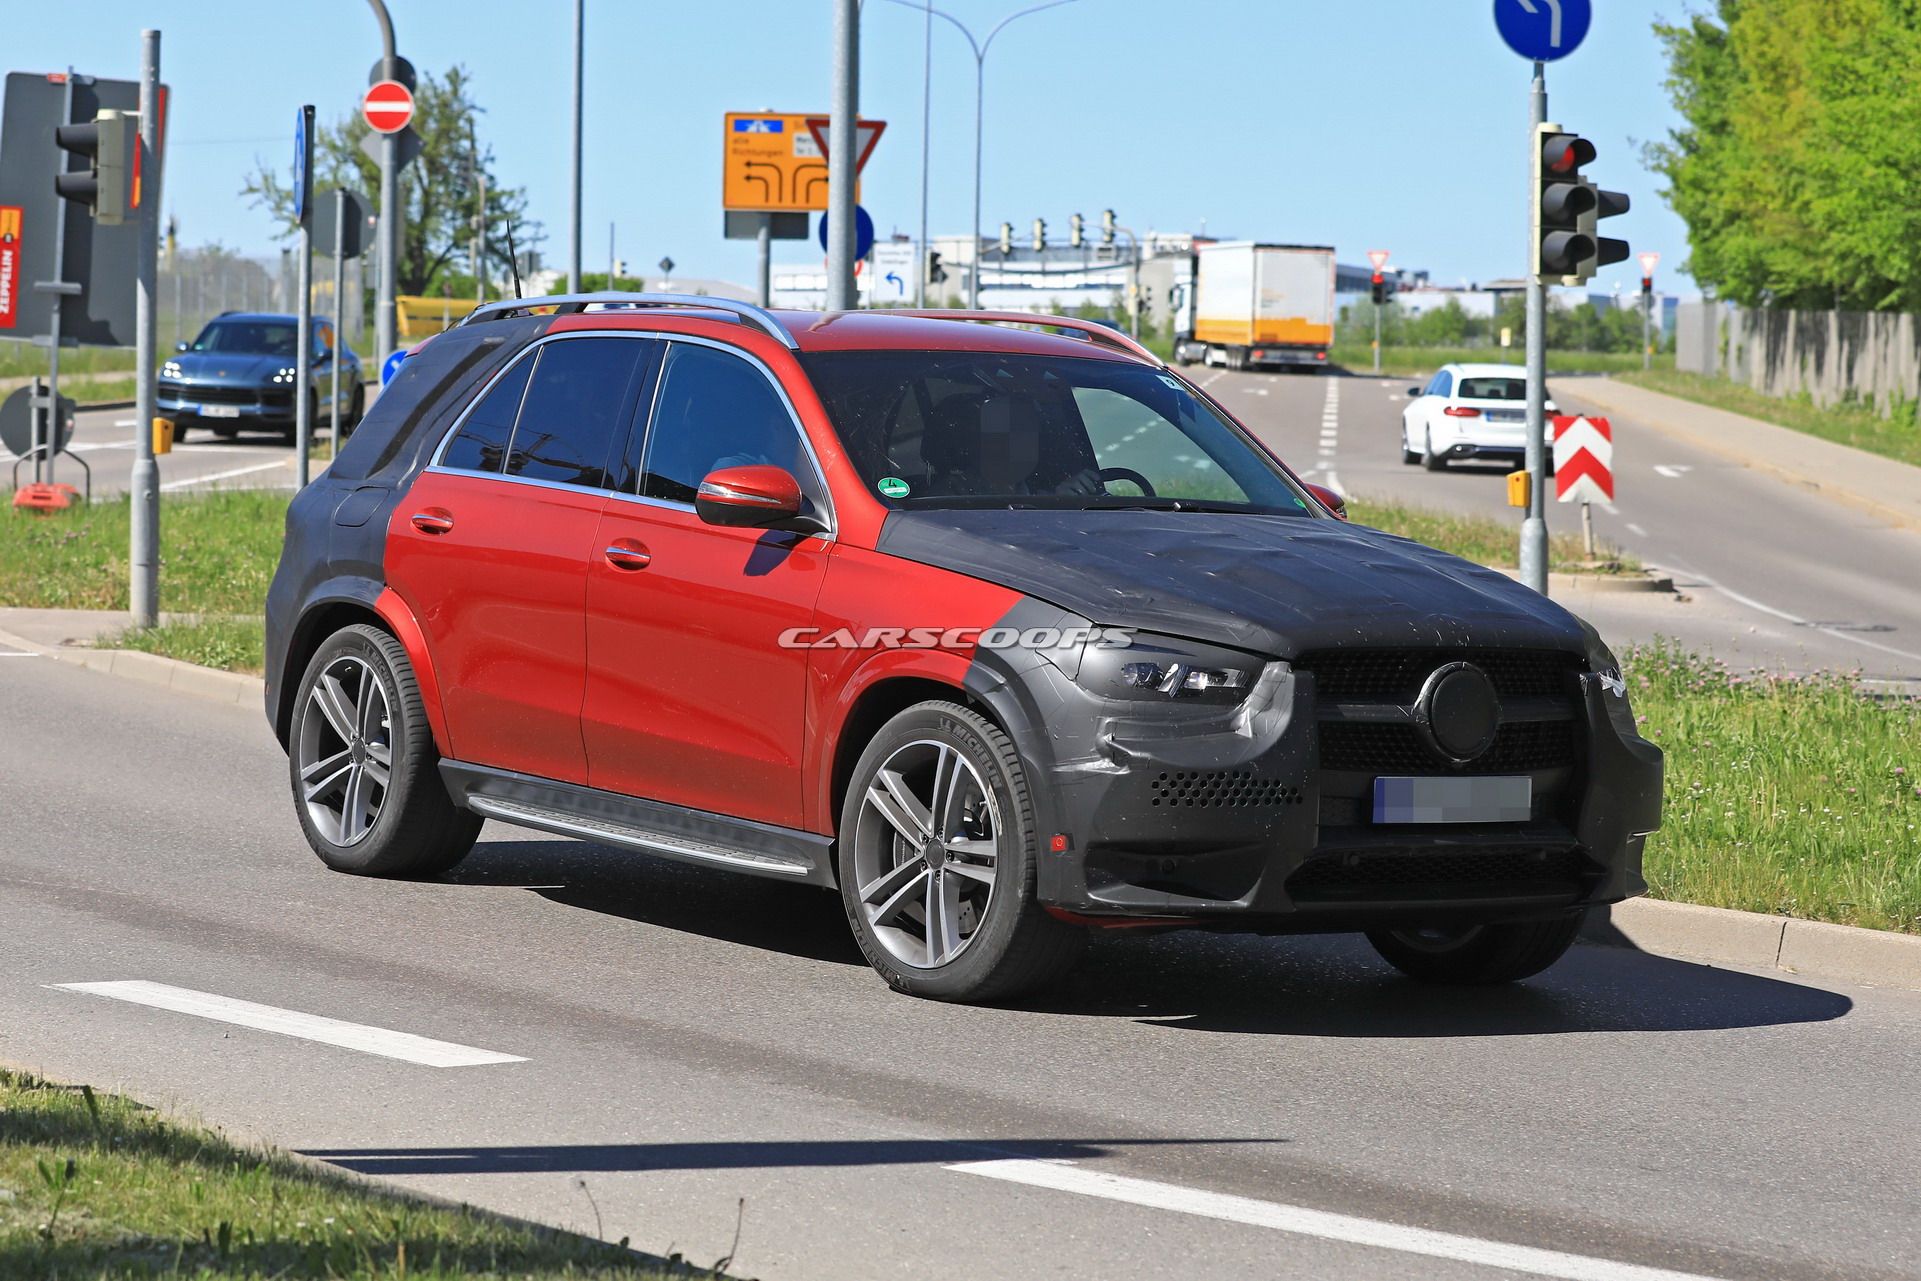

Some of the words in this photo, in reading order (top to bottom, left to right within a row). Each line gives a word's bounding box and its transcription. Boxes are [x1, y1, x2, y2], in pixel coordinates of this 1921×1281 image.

[0, 249, 13, 314] ZEPPELIN
[889, 479, 897, 487] 4
[953, 724, 1002, 789] MICHELIN
